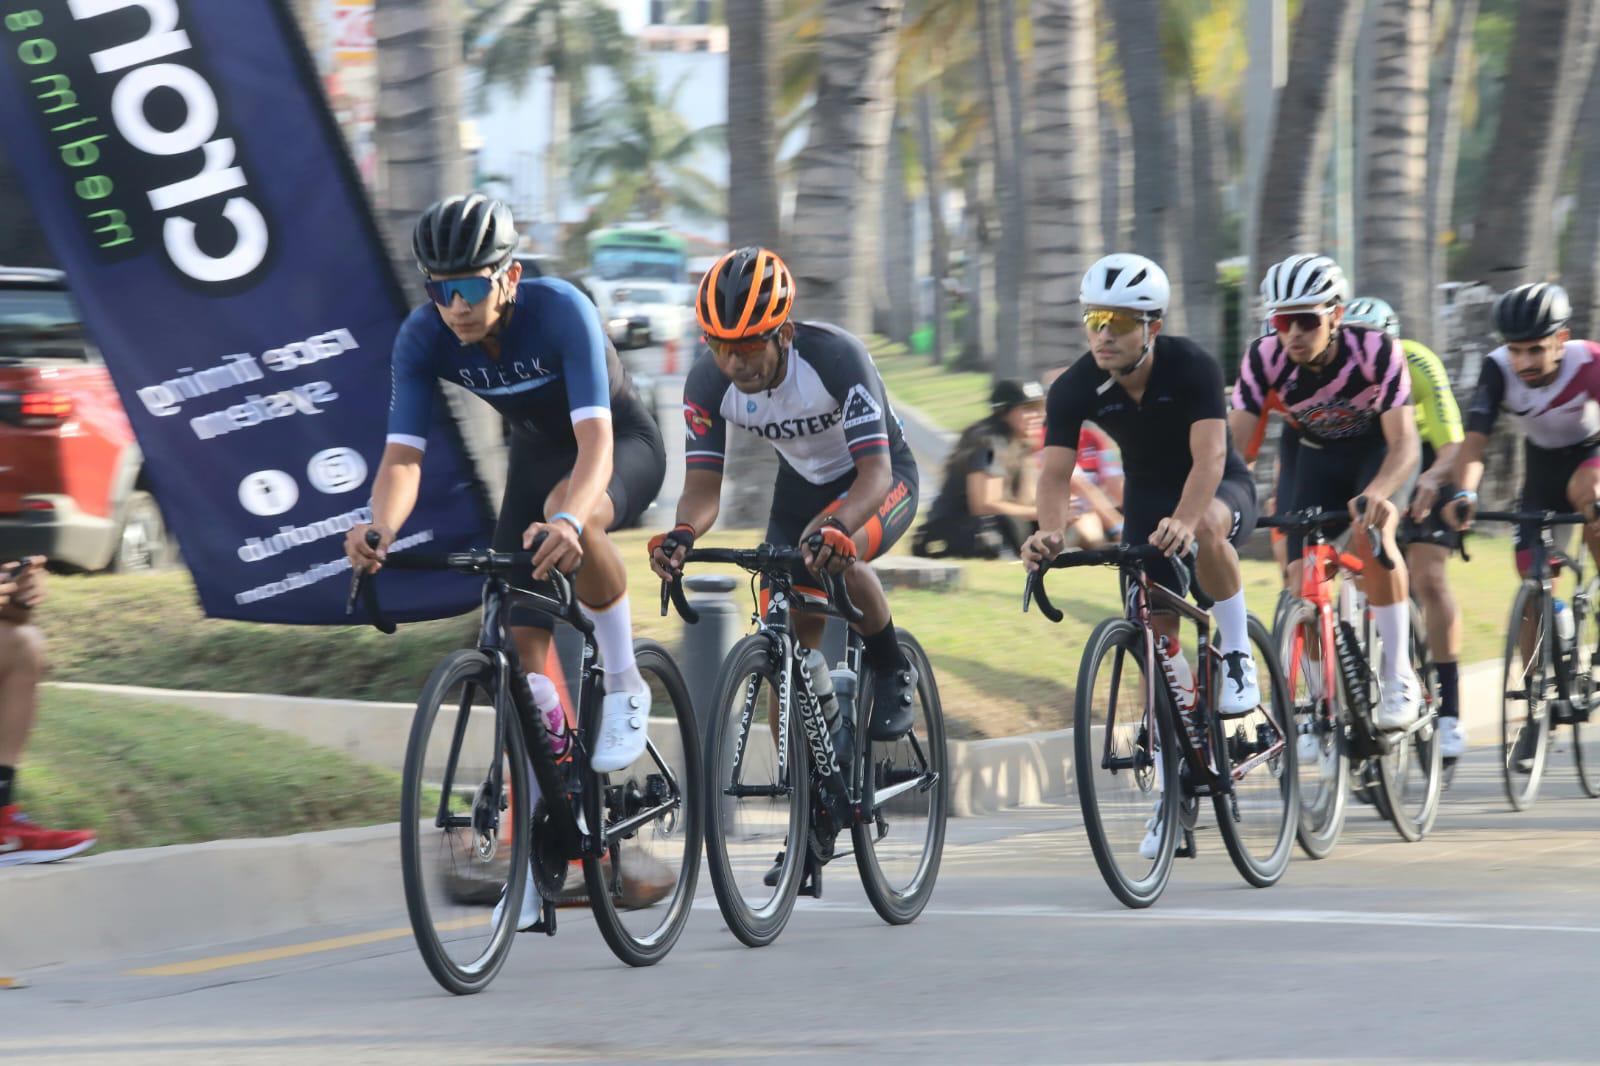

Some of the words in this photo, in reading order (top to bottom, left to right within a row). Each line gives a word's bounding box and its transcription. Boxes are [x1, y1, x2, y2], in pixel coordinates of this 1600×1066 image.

[734, 672, 757, 767] COLNAGO
[778, 671, 787, 767] COLNAGO
[798, 691, 831, 777] COLNAGO
